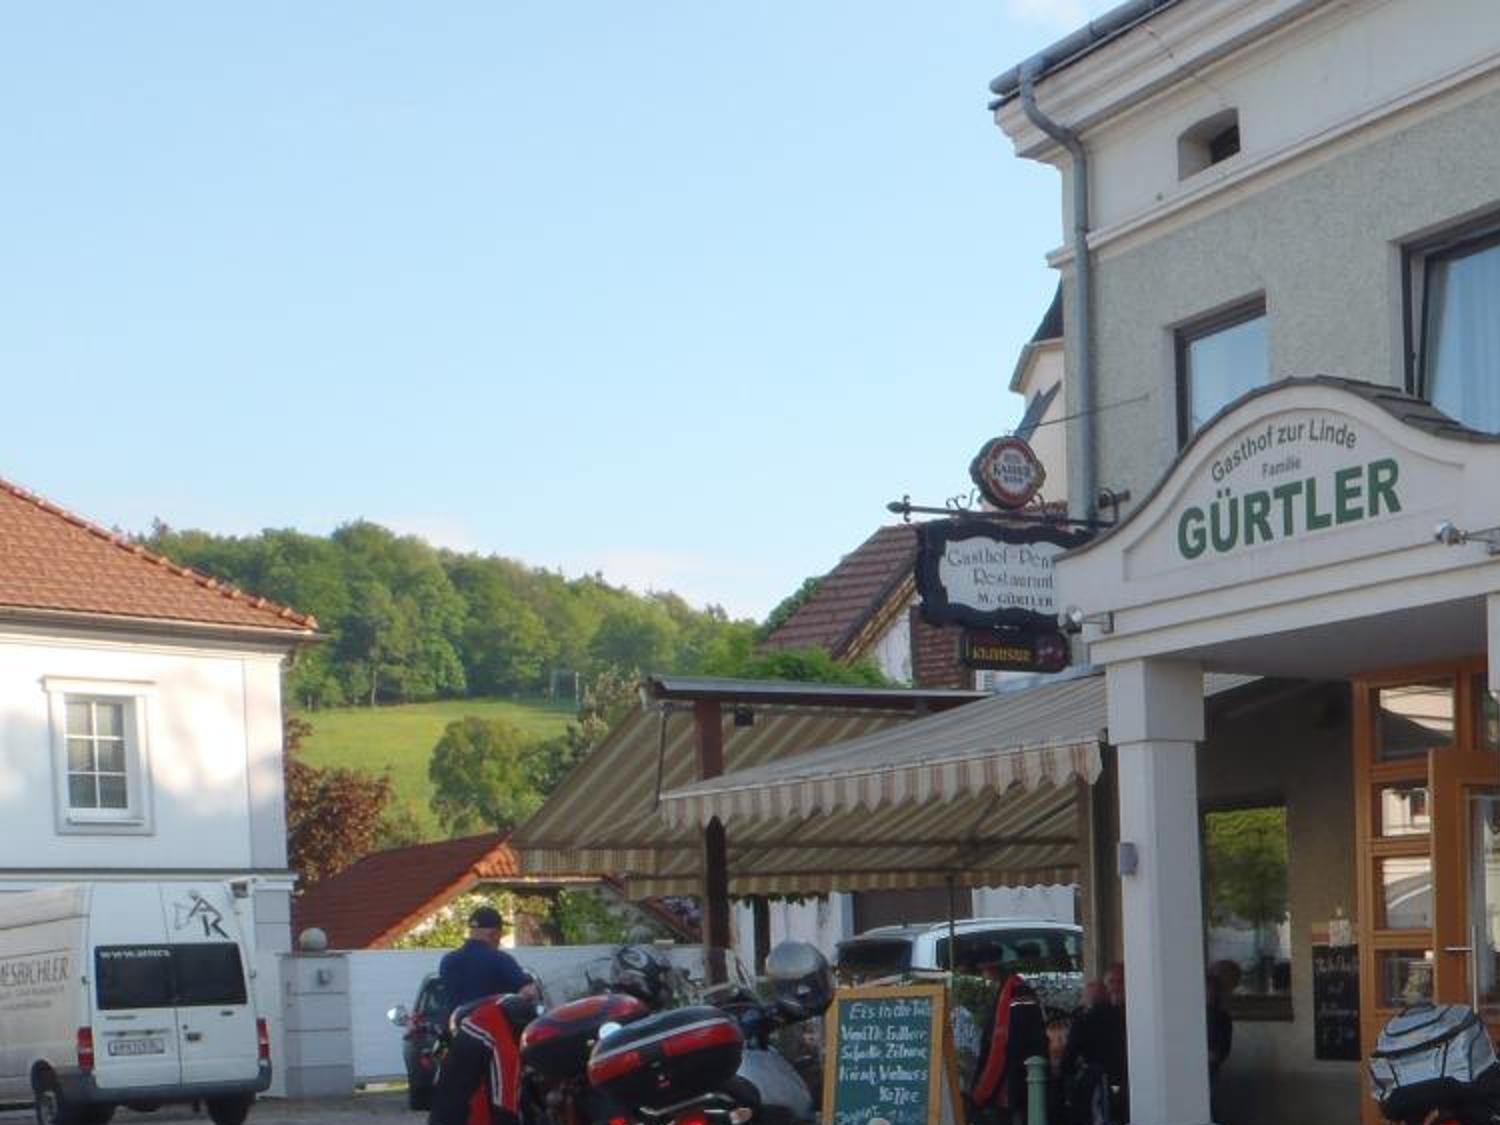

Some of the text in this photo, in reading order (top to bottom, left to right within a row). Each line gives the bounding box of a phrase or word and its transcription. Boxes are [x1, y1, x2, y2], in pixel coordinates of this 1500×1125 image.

[1211, 419, 1356, 482] Gasthof zur Linde
[1261, 456, 1302, 478] Familie
[1177, 457, 1402, 560] GÜRTLER
